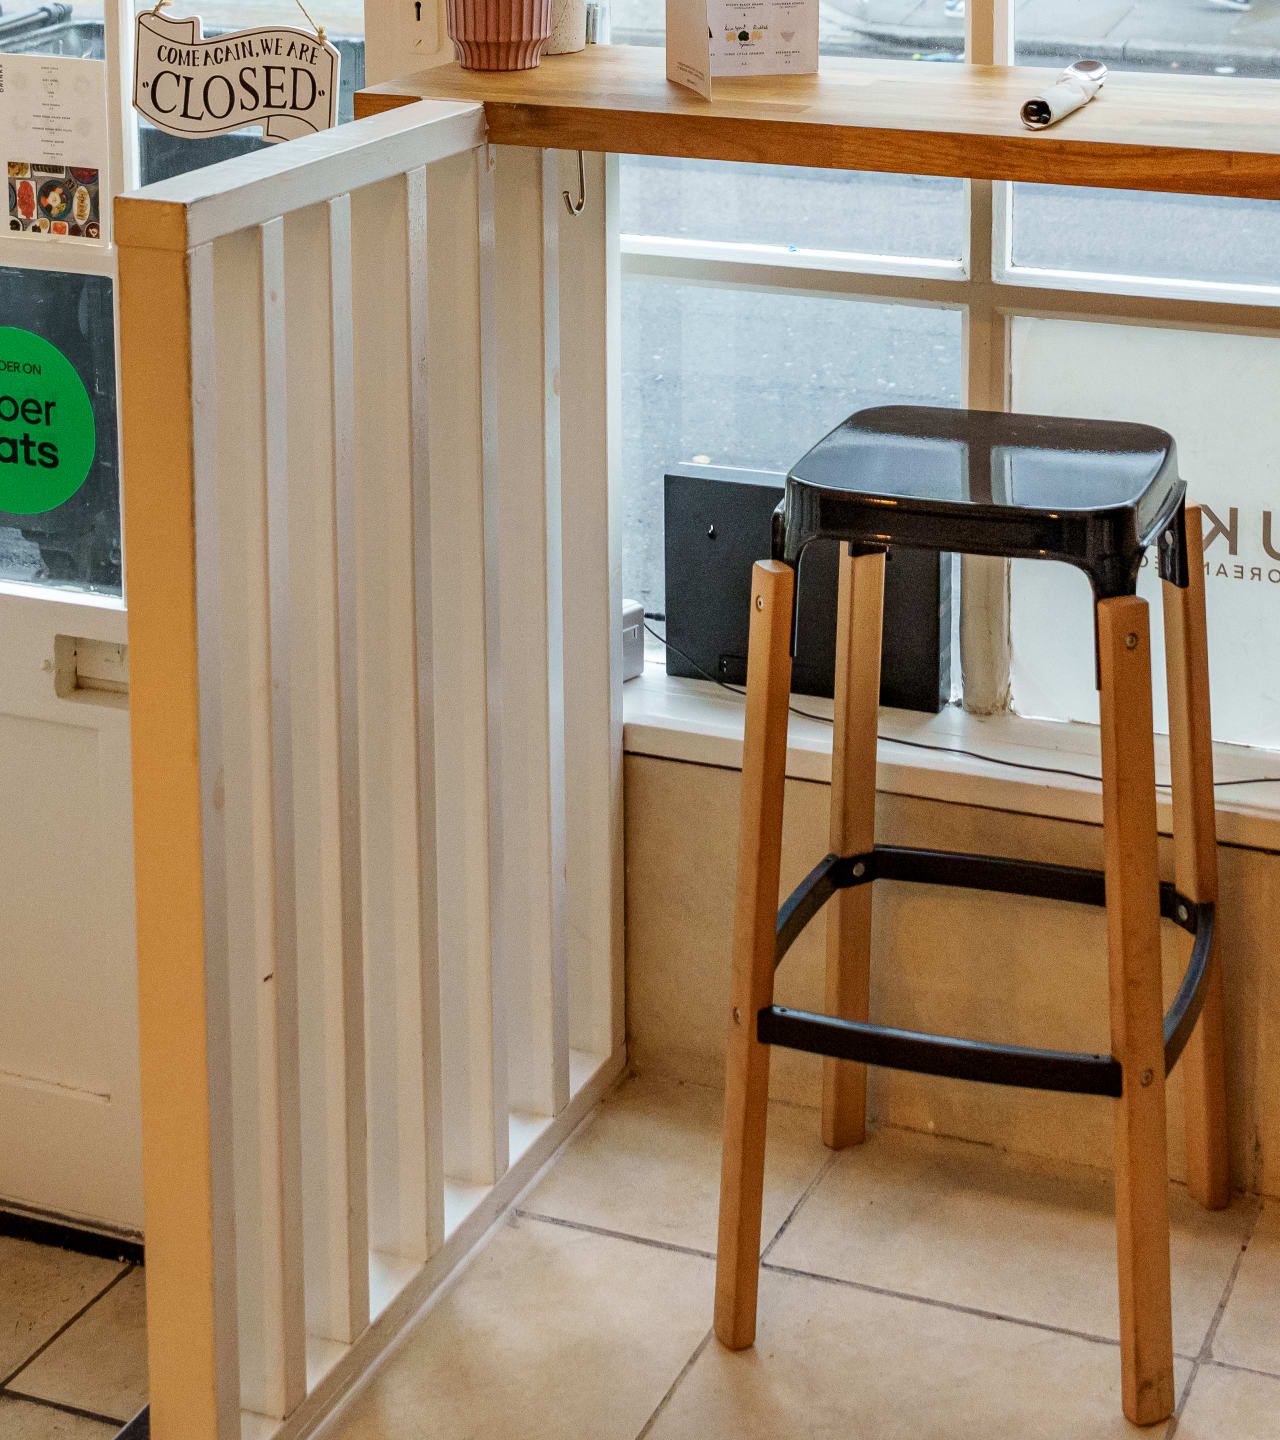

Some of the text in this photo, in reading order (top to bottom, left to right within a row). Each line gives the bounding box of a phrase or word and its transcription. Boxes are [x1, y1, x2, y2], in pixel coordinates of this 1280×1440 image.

[157, 38, 320, 67] COME AGAIN, WE ARE
[22, 362, 42, 376] ON
